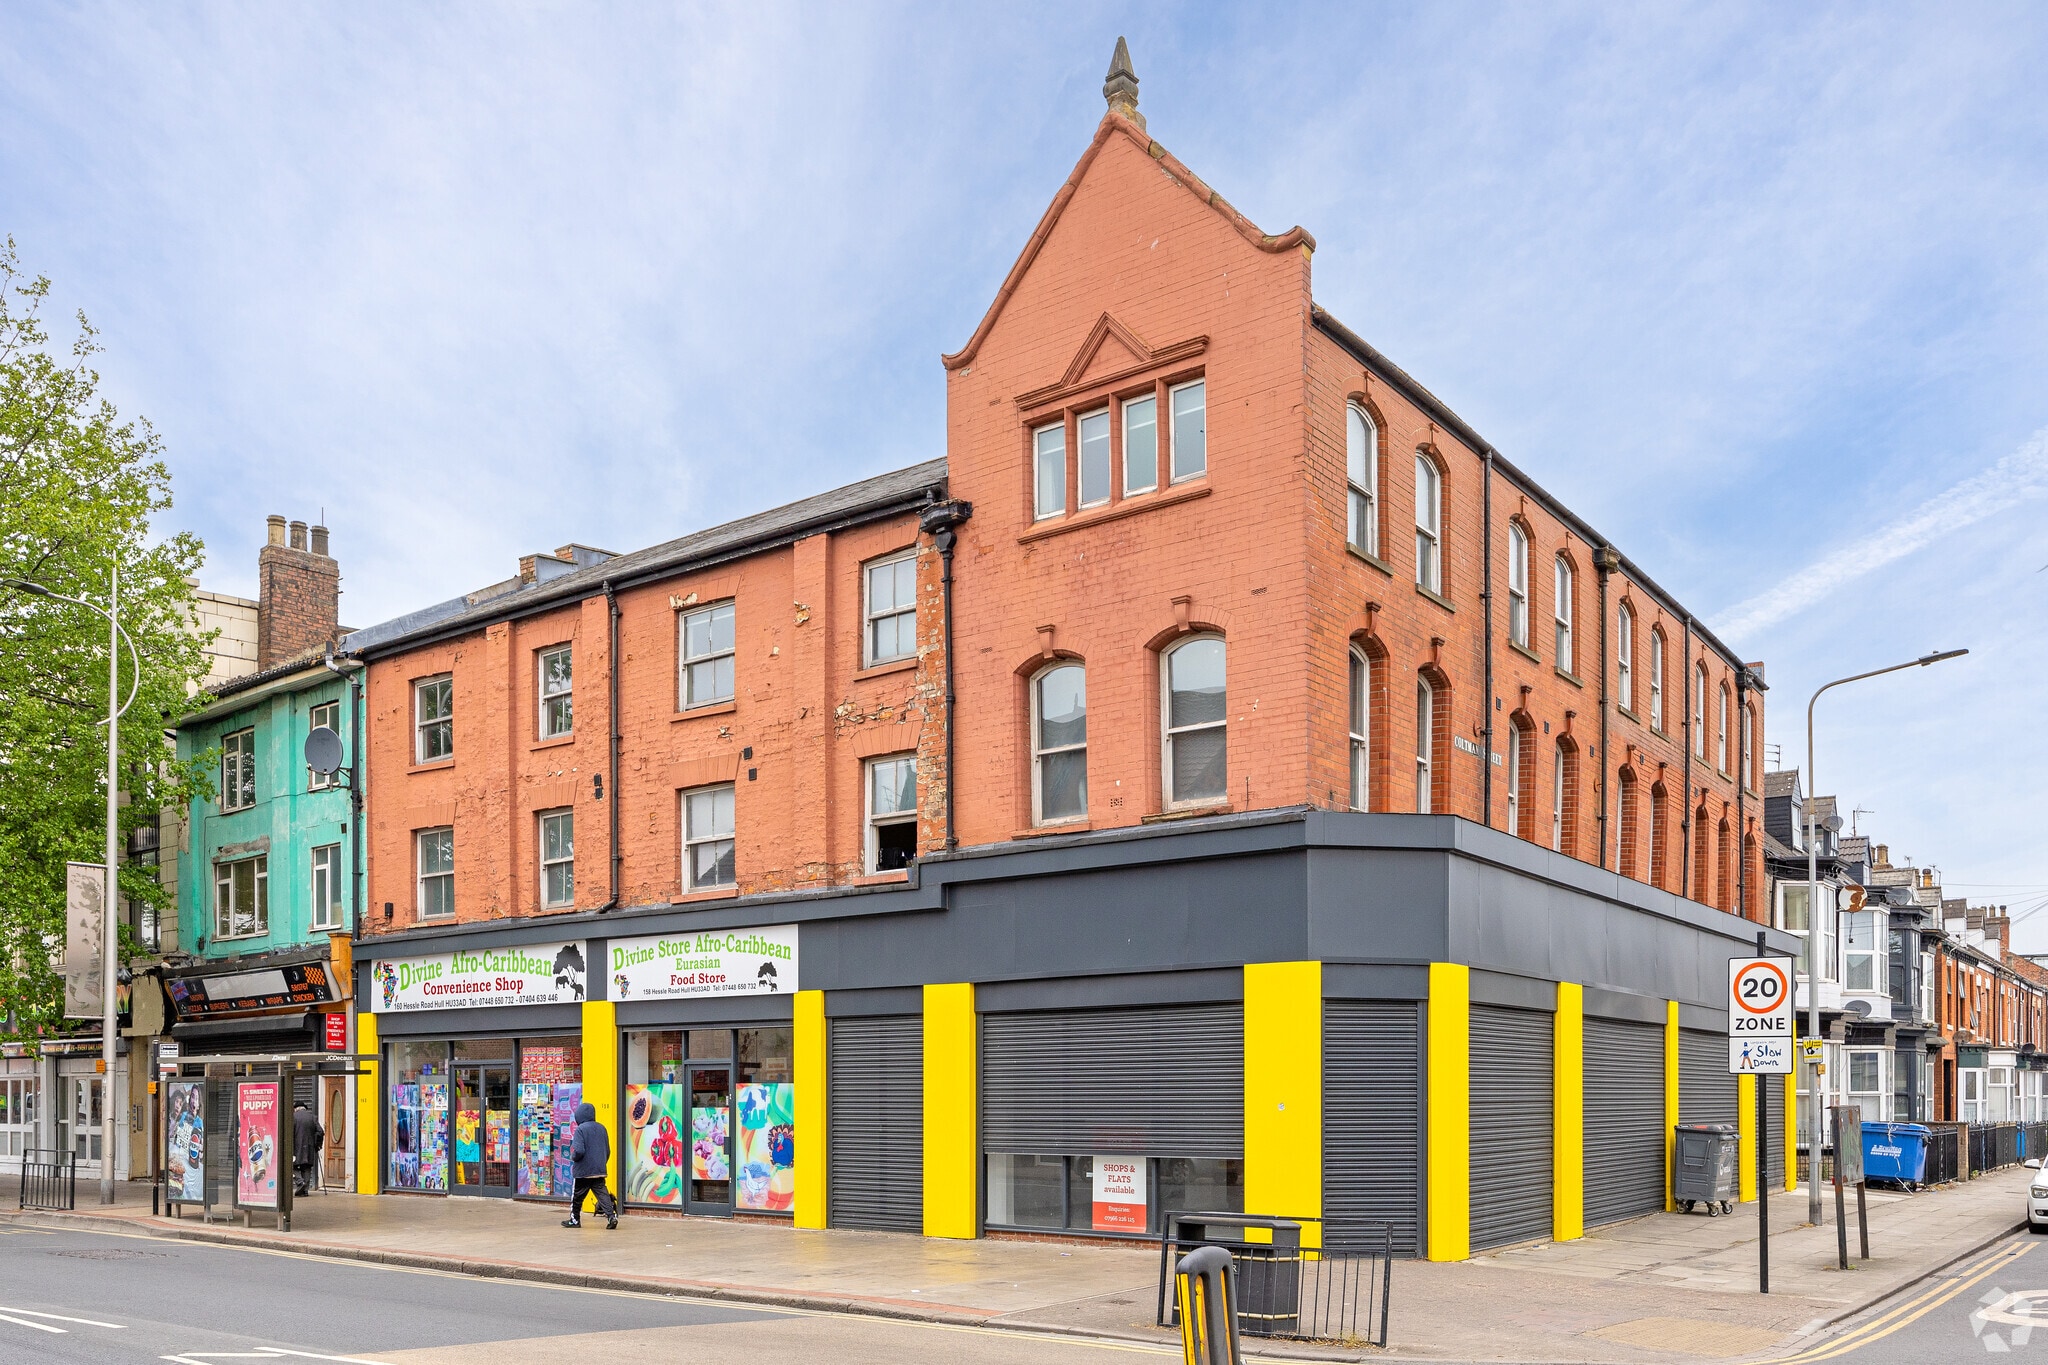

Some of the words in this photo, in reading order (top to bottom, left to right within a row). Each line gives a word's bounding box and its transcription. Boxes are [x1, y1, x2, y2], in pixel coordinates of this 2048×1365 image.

[613, 946, 655, 971] Divine
[658, 940, 691, 958] Store
[695, 933, 791, 960] Afro-Caribbean
[399, 960, 442, 991] Divine
[450, 949, 552, 977] Afro-Caribbean
[675, 956, 720, 970] Eurasian
[423, 980, 491, 995] Convenience
[495, 977, 523, 994] Shop
[670, 973, 695, 986] Food
[698, 972, 726, 985] Store
[643, 988, 651, 996] 158
[652, 987, 667, 995] Hessle
[668, 986, 680, 994] Road
[681, 985, 690, 993] Hull
[713, 983, 721, 992] Tel:
[722, 983, 737, 992] 07448
[737, 982, 747, 991] 650
[747, 982, 757, 990] 732
[1743, 977, 1778, 998] 20
[265, 996, 284, 1005] WRAPS
[292, 993, 315, 1002] CHICKEN
[394, 1002, 402, 1010] 160
[403, 1001, 420, 1010] Hessle
[421, 1000, 433, 1009] Road
[434, 1000, 445, 1008] Hull
[469, 998, 478, 1006] Tel:
[505, 995, 514, 1004] 732
[536, 993, 546, 1003] 639
[547, 993, 558, 1002] 446
[1735, 1017, 1785, 1031] ZONE
[1756, 1044, 1782, 1058] Slow
[1753, 1059, 1779, 1067] Down
[243, 1101, 274, 1110] PUPPY
[1104, 1164, 1128, 1172] SHOPS
[1130, 1165, 1136, 1173] &
[1108, 1175, 1131, 1183] FLATS
[1104, 1186, 1135, 1194] available
